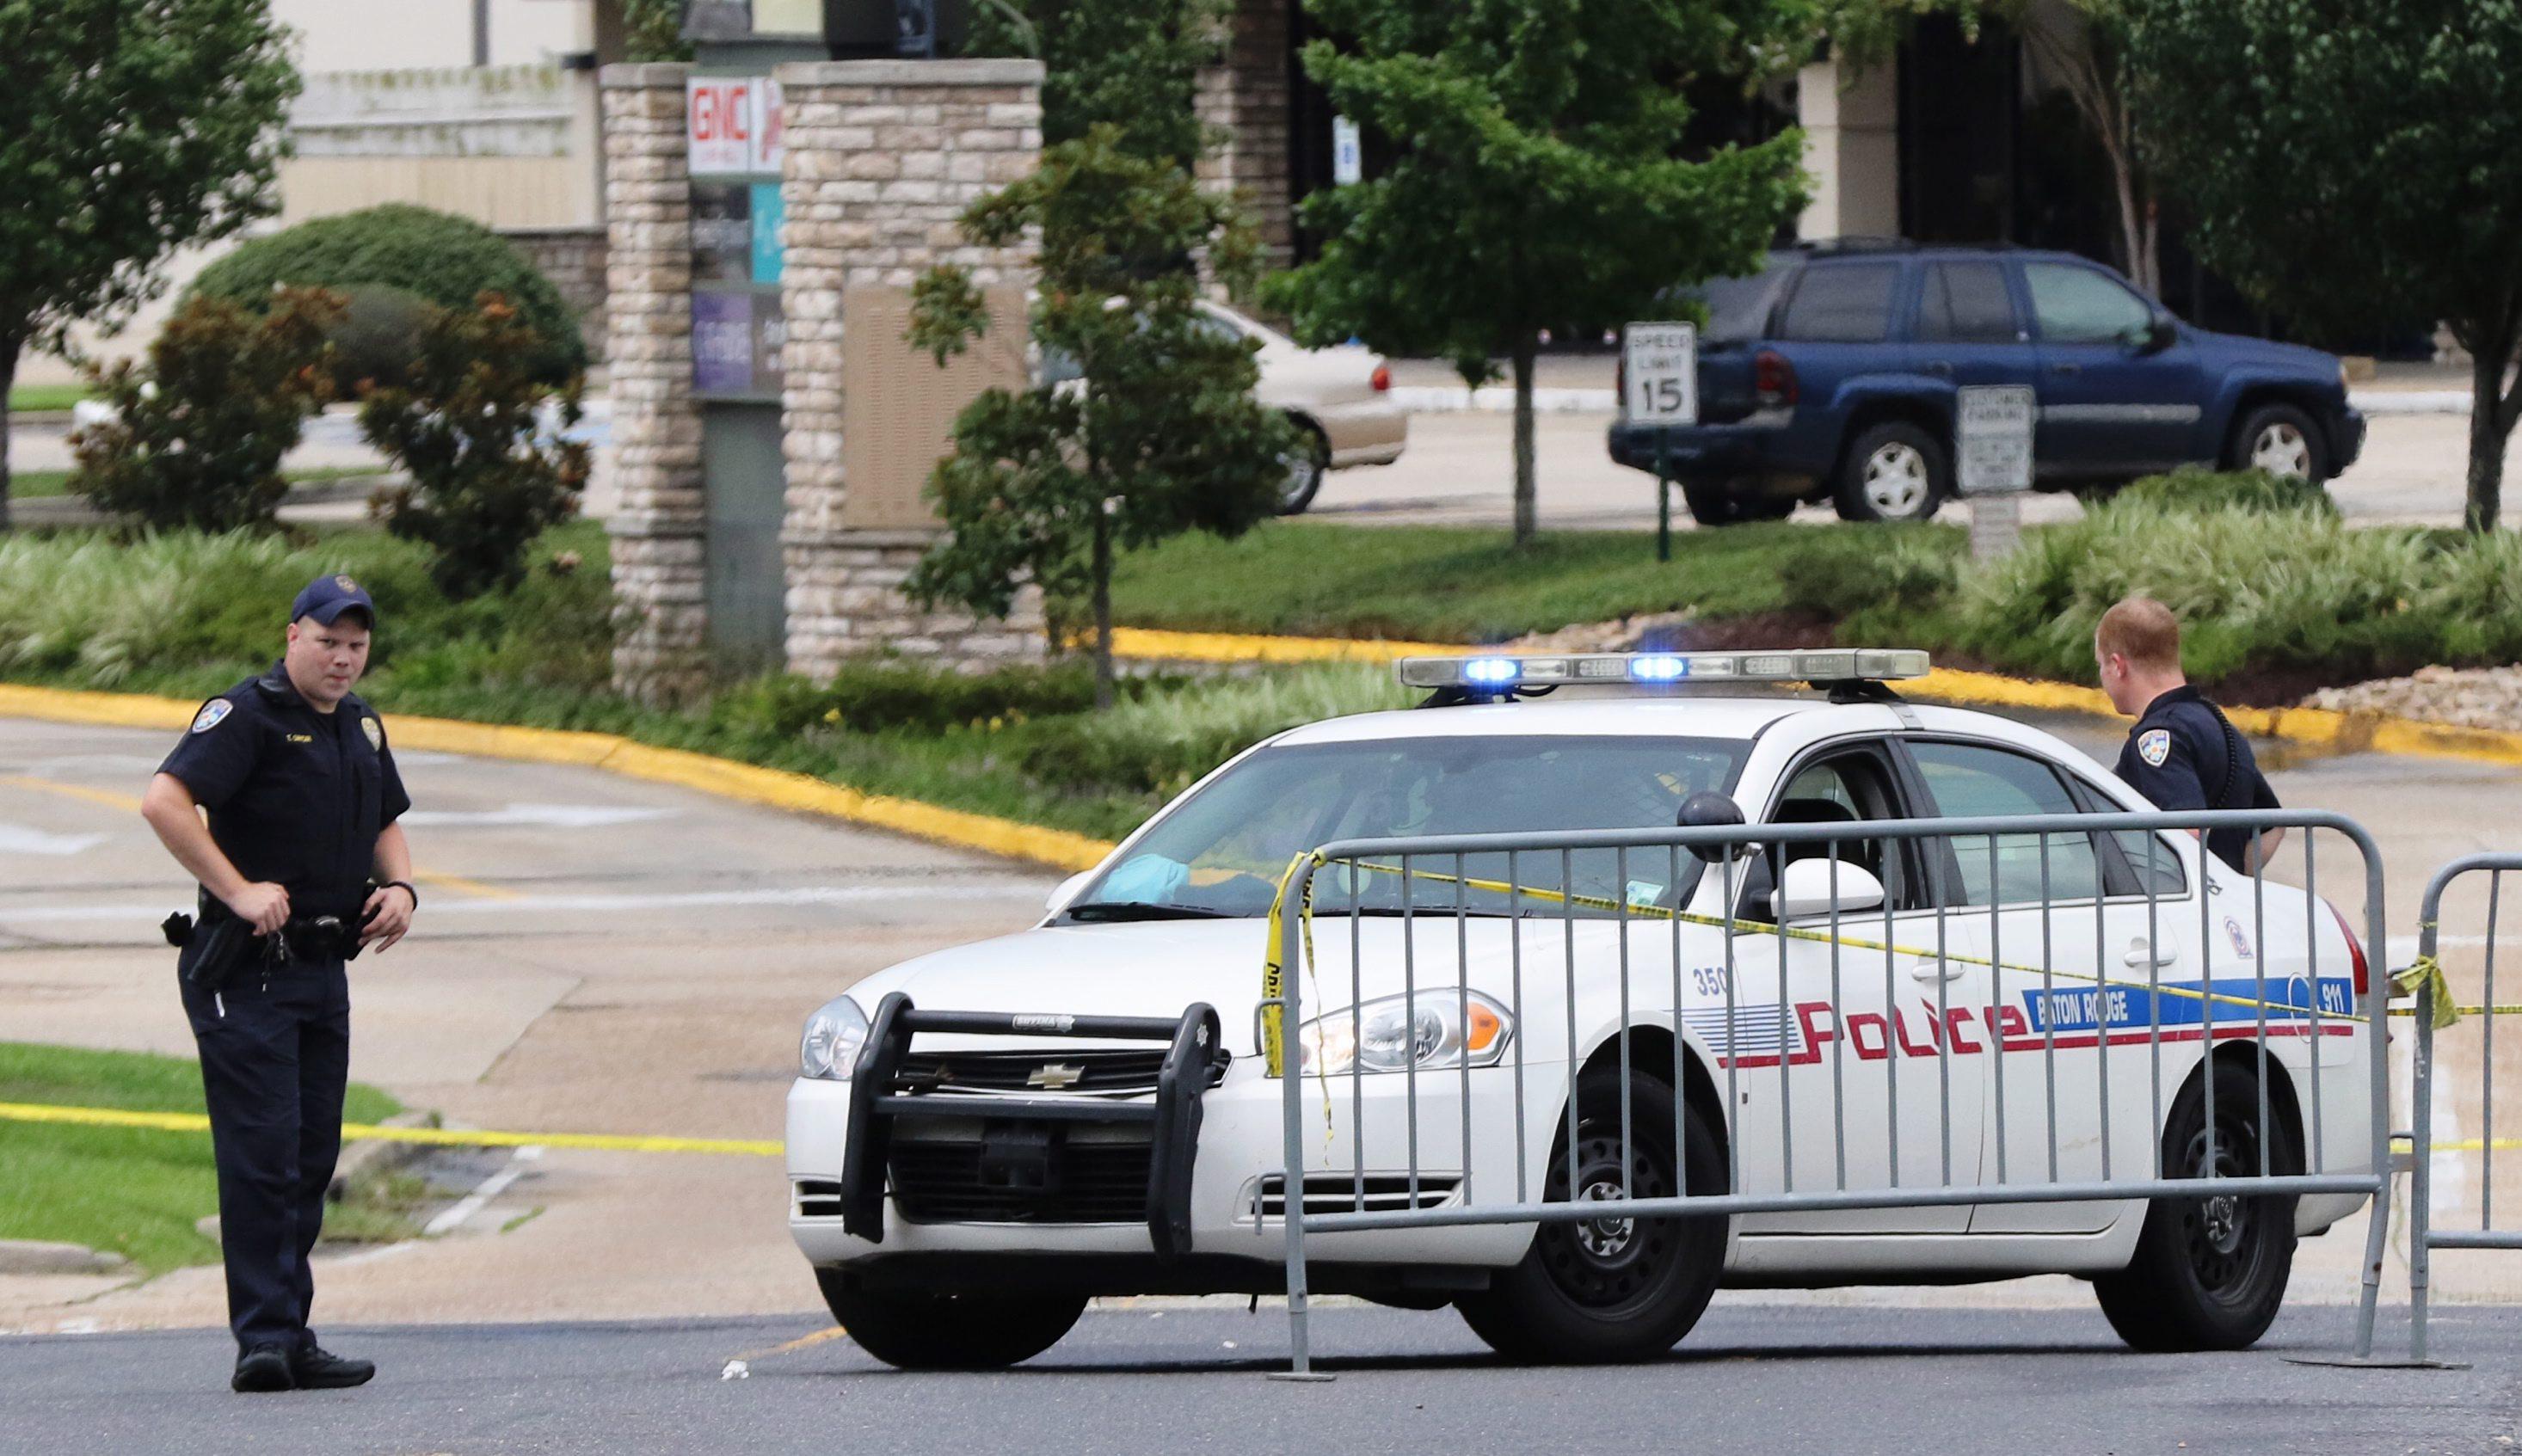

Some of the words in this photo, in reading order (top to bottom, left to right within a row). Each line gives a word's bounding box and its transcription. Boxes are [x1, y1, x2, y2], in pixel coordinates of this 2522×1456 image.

[692, 87, 748, 140] GNC
[1633, 334, 1691, 347] SPEED
[1637, 353, 1681, 369] LIMIT
[1642, 378, 1682, 413] 15
[2322, 983, 2345, 1013] 911
